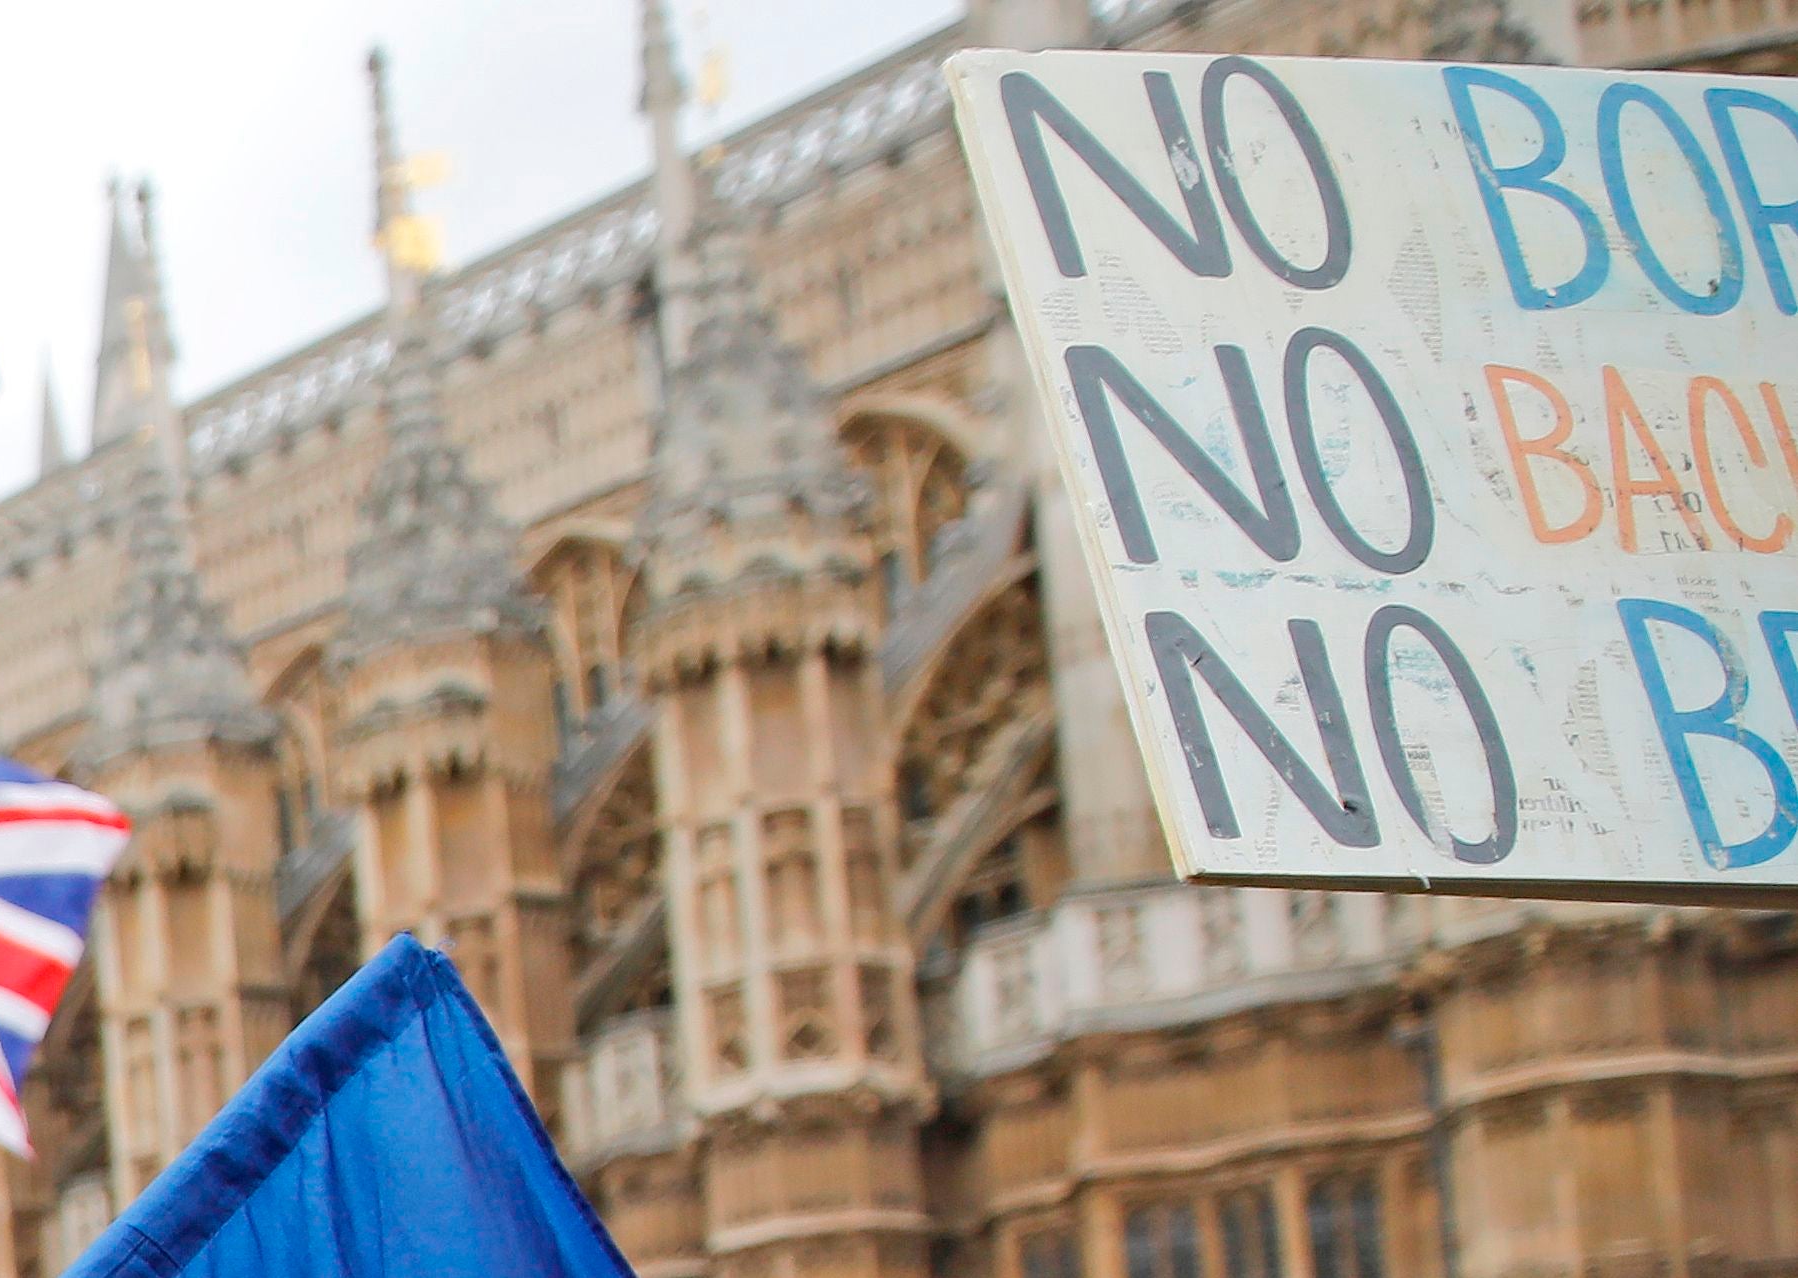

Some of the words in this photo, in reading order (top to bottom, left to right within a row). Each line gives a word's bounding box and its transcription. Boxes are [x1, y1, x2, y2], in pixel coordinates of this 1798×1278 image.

[1000, 57, 1352, 289] NO
[1442, 66, 1798, 315] BOR
[1065, 326, 1435, 575] NO
[1145, 603, 1518, 864] NO
